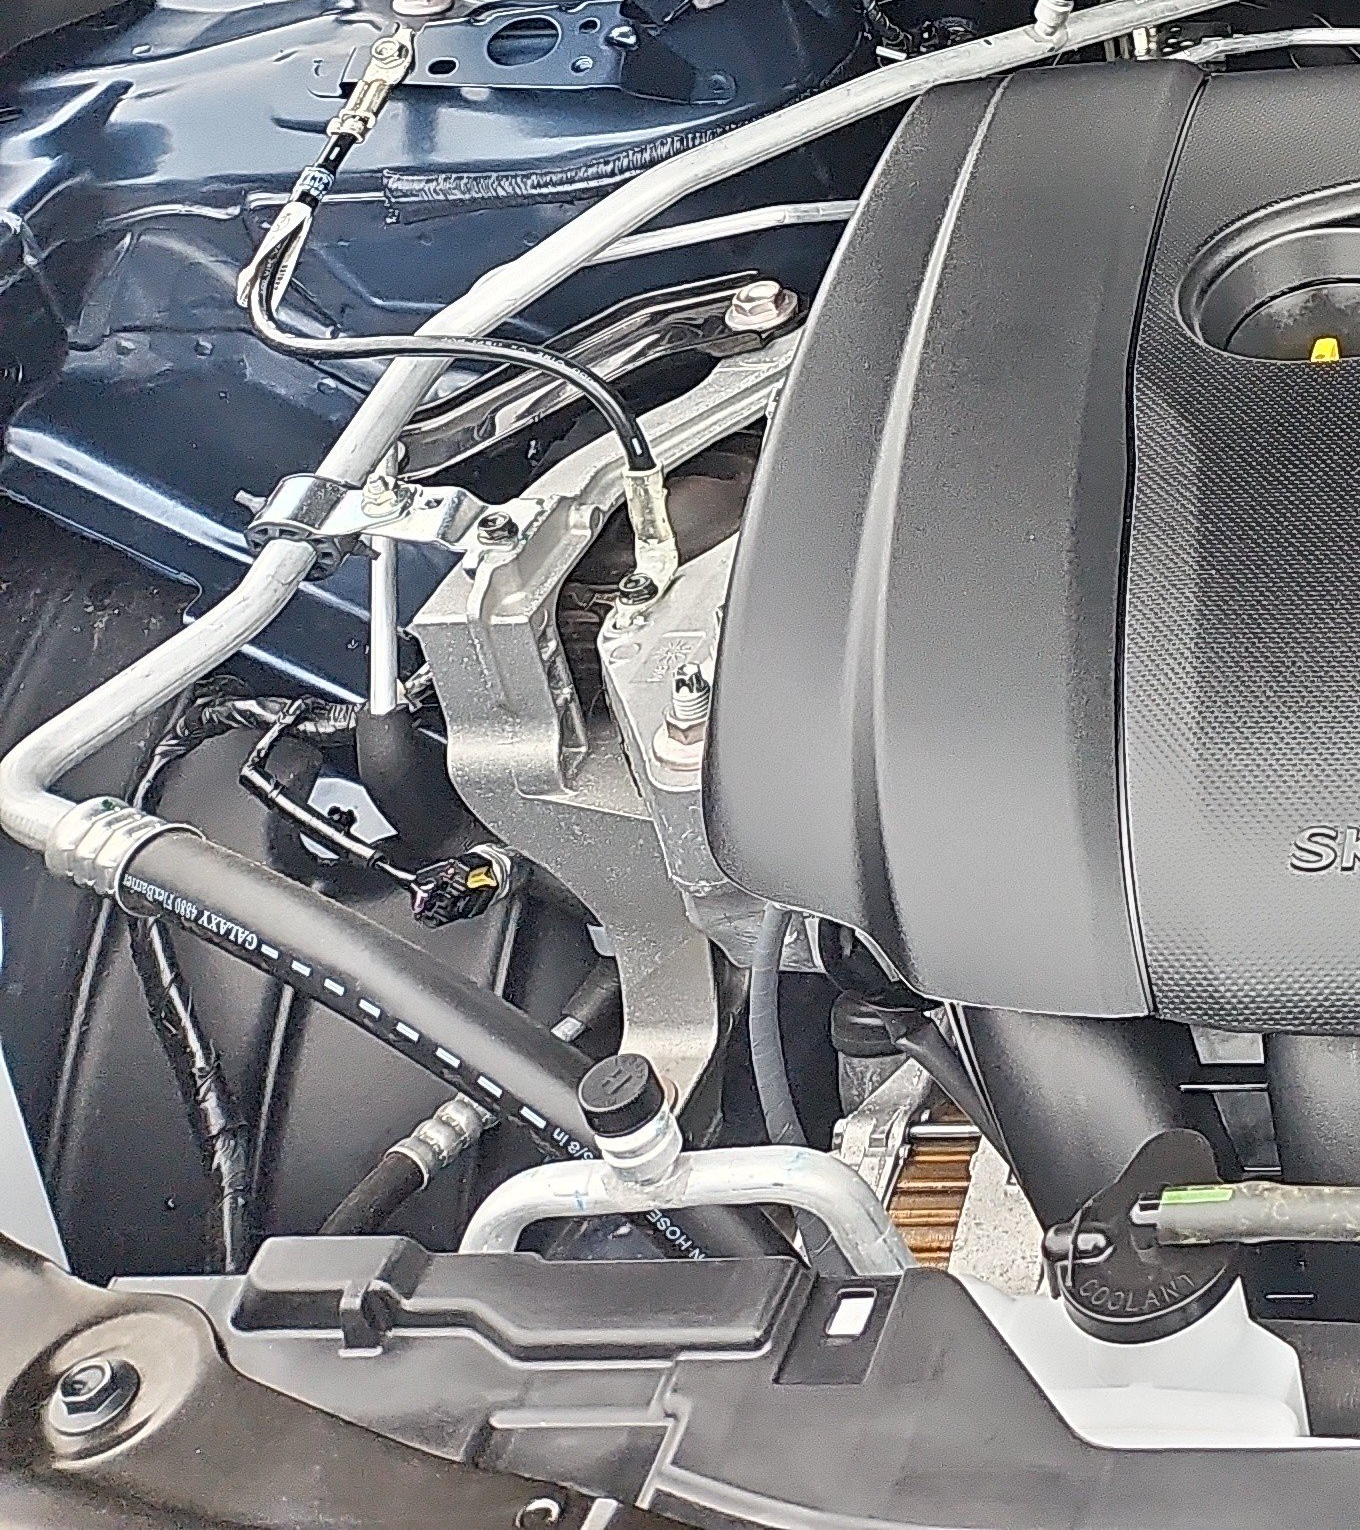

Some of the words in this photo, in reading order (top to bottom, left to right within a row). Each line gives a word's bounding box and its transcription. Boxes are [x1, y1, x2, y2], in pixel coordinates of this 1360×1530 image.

[123, 873, 176, 910] FlexBarrier
[174, 897, 198, 921] 4880
[197, 909, 259, 951] GALAXY
[1078, 1273, 1196, 1313] COOLANT
